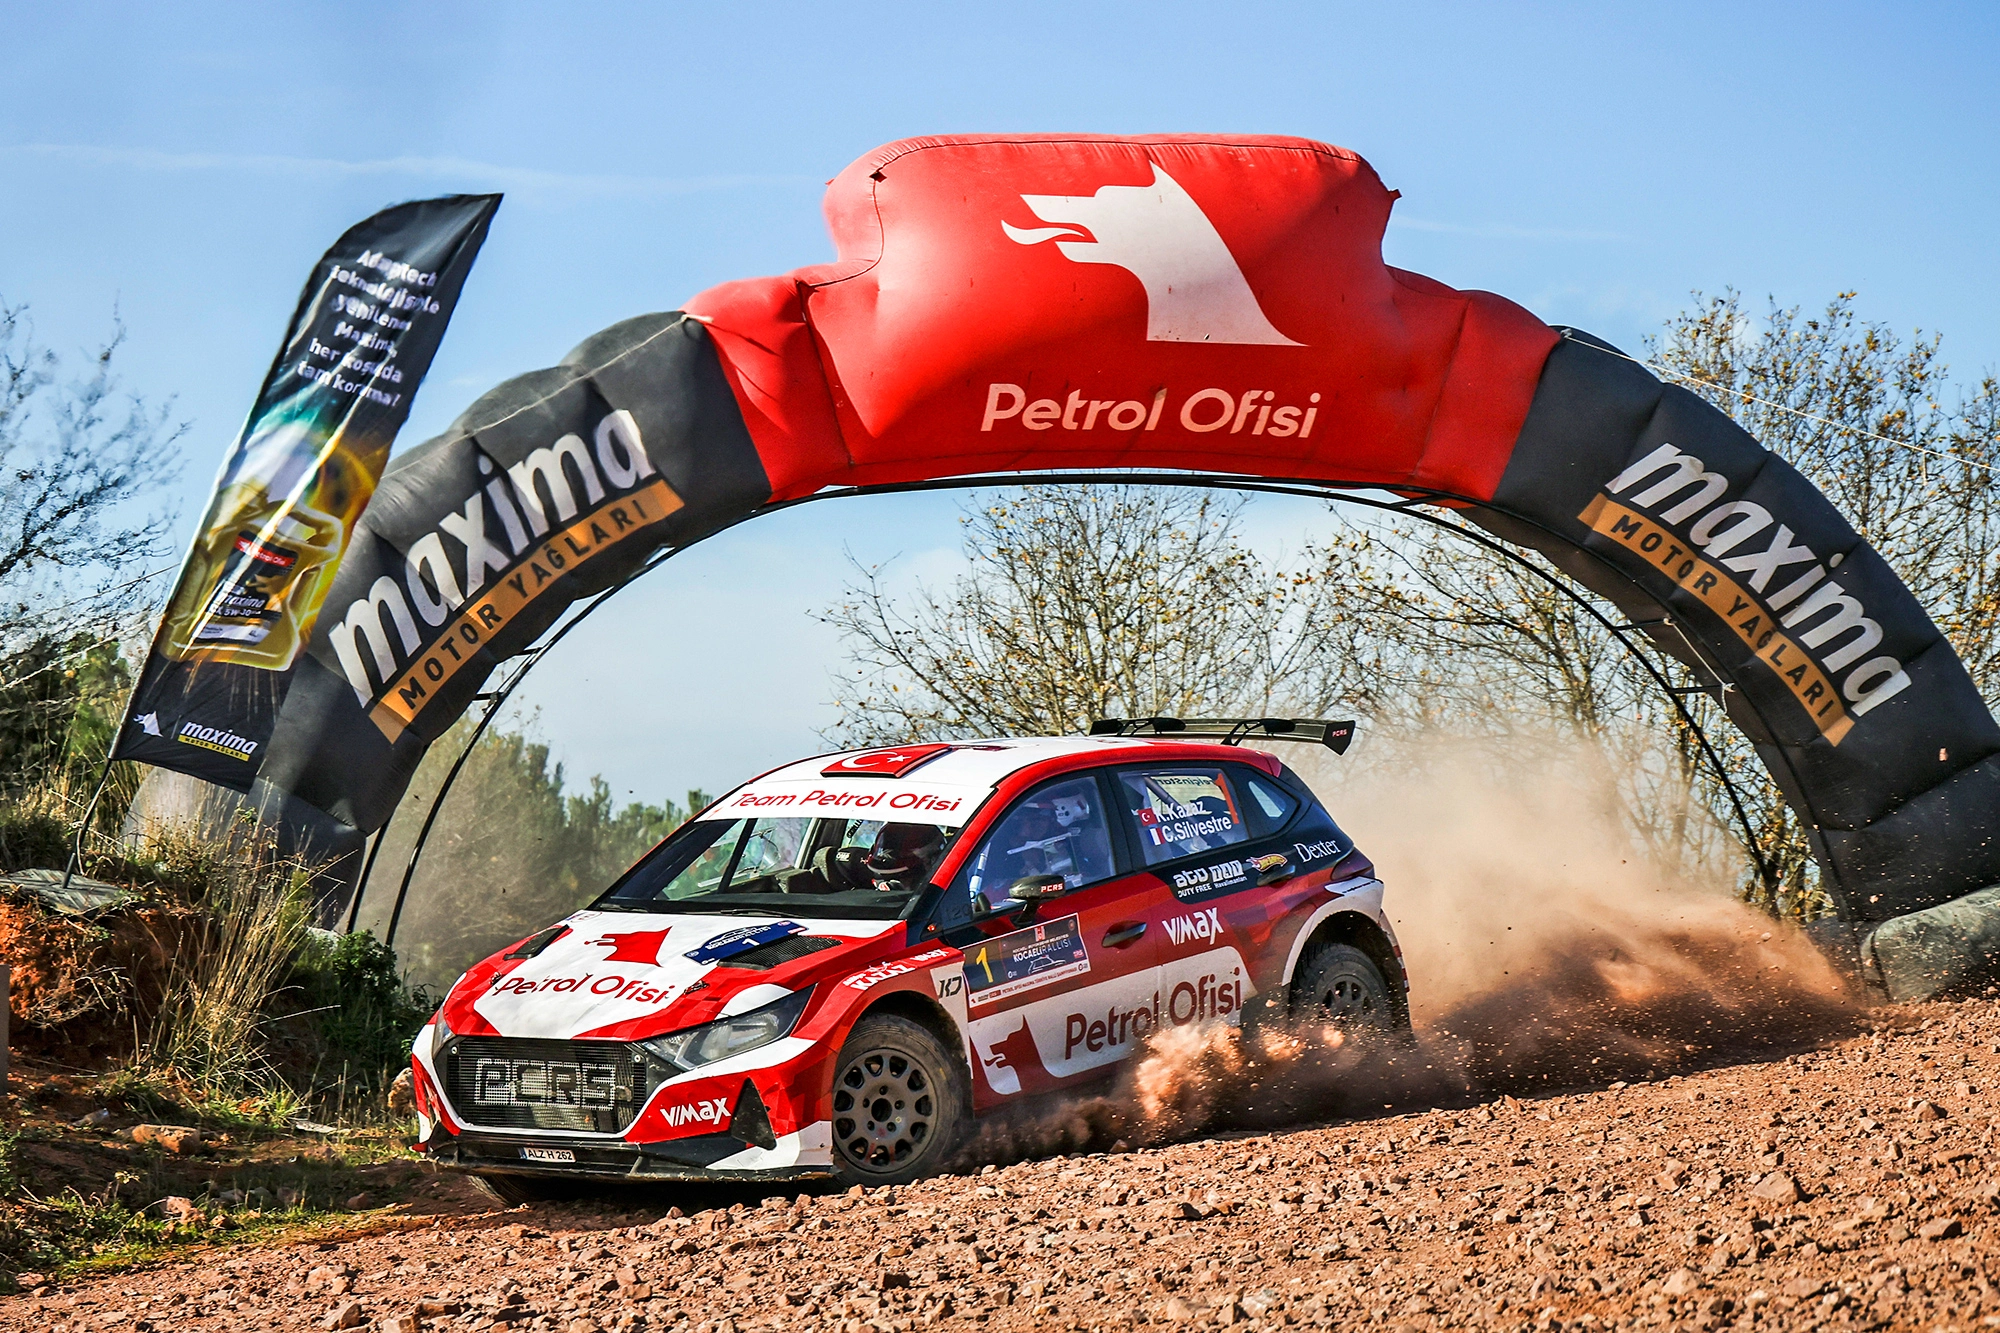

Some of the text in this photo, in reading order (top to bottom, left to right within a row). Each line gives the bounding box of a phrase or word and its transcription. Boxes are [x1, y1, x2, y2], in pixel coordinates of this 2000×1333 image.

[309, 337, 403, 383] her koşuda
[333, 374, 402, 407] korma!
[980, 383, 1321, 438] Petrol Ofisi
[328, 409, 655, 708] maxima
[1605, 443, 1912, 717] maxima
[398, 500, 647, 711] MOTOR YAĞLARI
[1611, 514, 1834, 718] MOTOR YAĞLARI
[180, 721, 258, 754] maxima
[185, 737, 210, 748] MOTOR
[730, 789, 962, 811] Team Petrol Ofisi
[1161, 815, 1232, 842] C.Silvestre
[1293, 839, 1341, 862] Dexter
[1040, 882, 1063, 893] PCRS
[1177, 882, 1212, 897] DUTY FREE
[742, 938, 760, 946] 1
[976, 947, 993, 983] 1
[492, 973, 676, 1004] Petrol Ofisi
[1065, 966, 1242, 1060] Petrol Ofisi
[474, 1058, 616, 1111] PCRS
[528, 1150, 573, 1160] ALZ H 262
